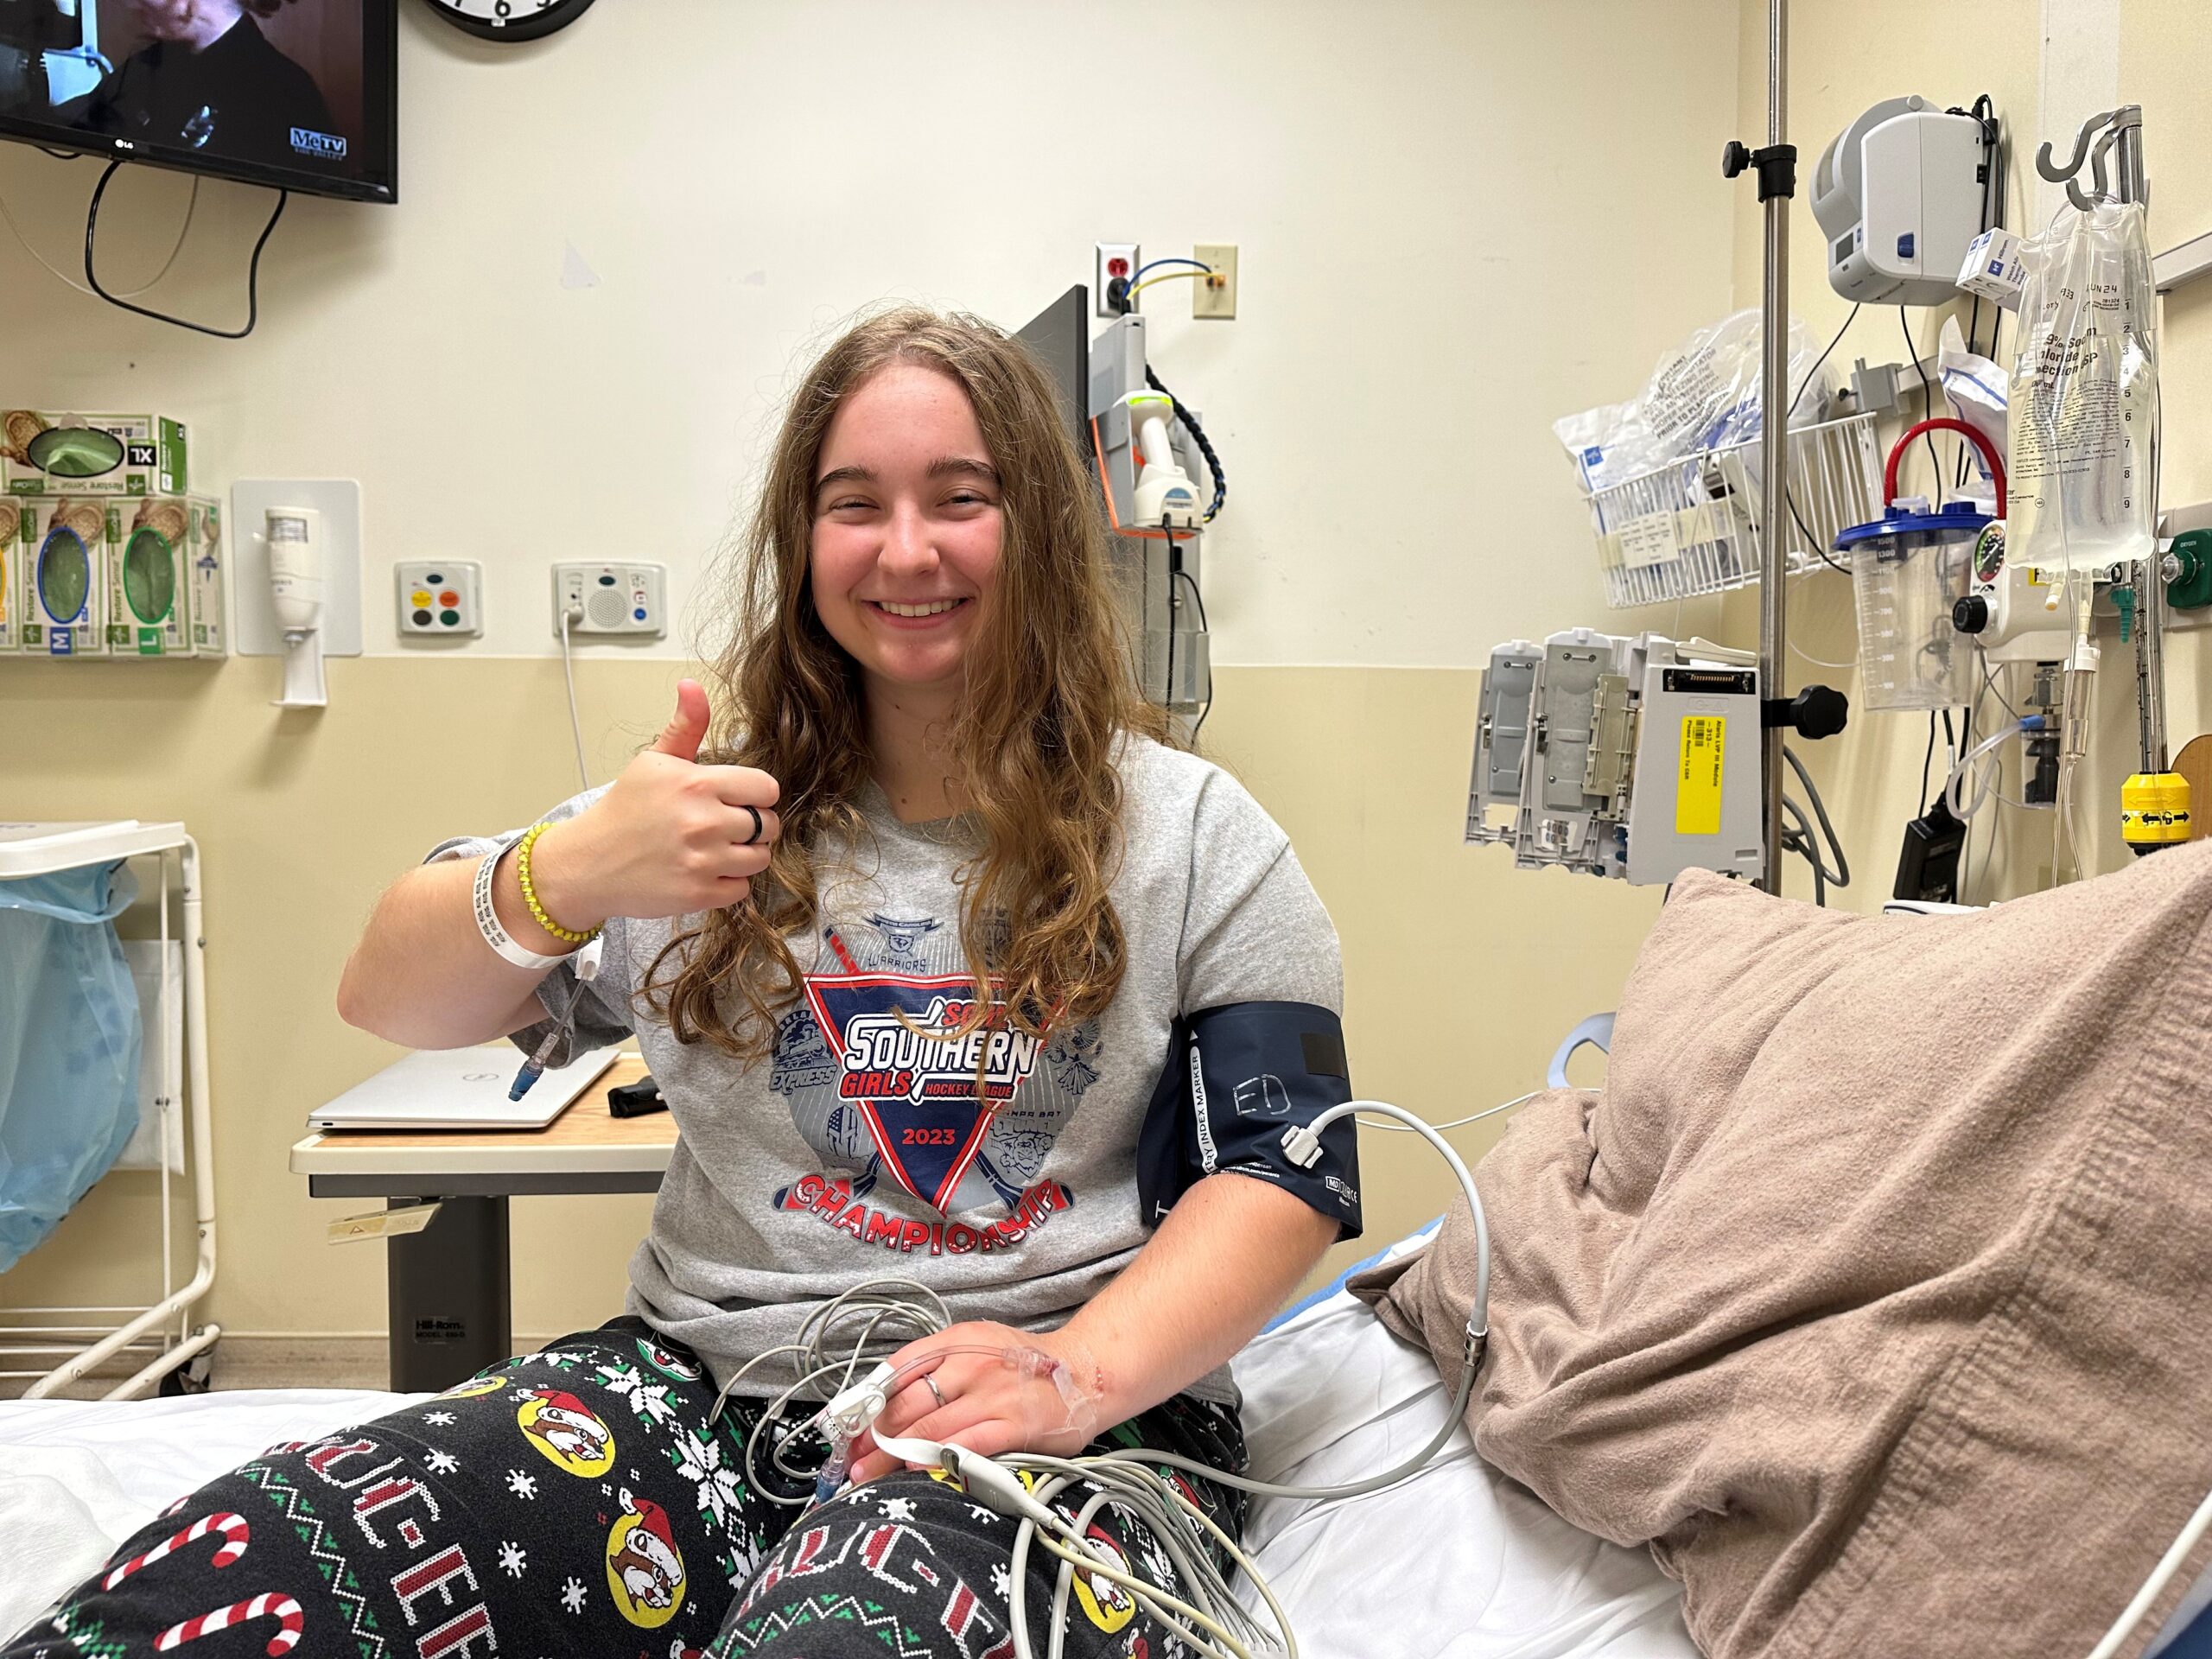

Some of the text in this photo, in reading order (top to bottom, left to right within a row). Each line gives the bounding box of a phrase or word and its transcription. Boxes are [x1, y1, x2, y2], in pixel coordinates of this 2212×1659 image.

[124, 141, 134, 149] LG
[293, 130, 343, 152] MeTV
[2103, 285, 2117, 294] 24
[2046, 334, 2063, 348] 9%
[130, 448, 152, 463] XL
[90, 480, 124, 491] Restore
[52, 632, 69, 649] M
[141, 635, 157, 647] L
[868, 953, 926, 973] WARRIORS
[846, 1017, 1035, 1074] SOUTHERN
[769, 1065, 838, 1096] EXPRESS
[841, 1070, 912, 1097] GIRLS
[1192, 1055, 1203, 1106] MARKER
[925, 1083, 1013, 1097] HOCKEY LAGUE
[1233, 1073, 1291, 1116] ED
[1198, 1108, 1210, 1145] INDEX
[902, 1128, 955, 1146] 2023
[794, 1174, 1055, 1255] CHAMPIONSHIP
[416, 1320, 461, 1330] Hill-Rom
